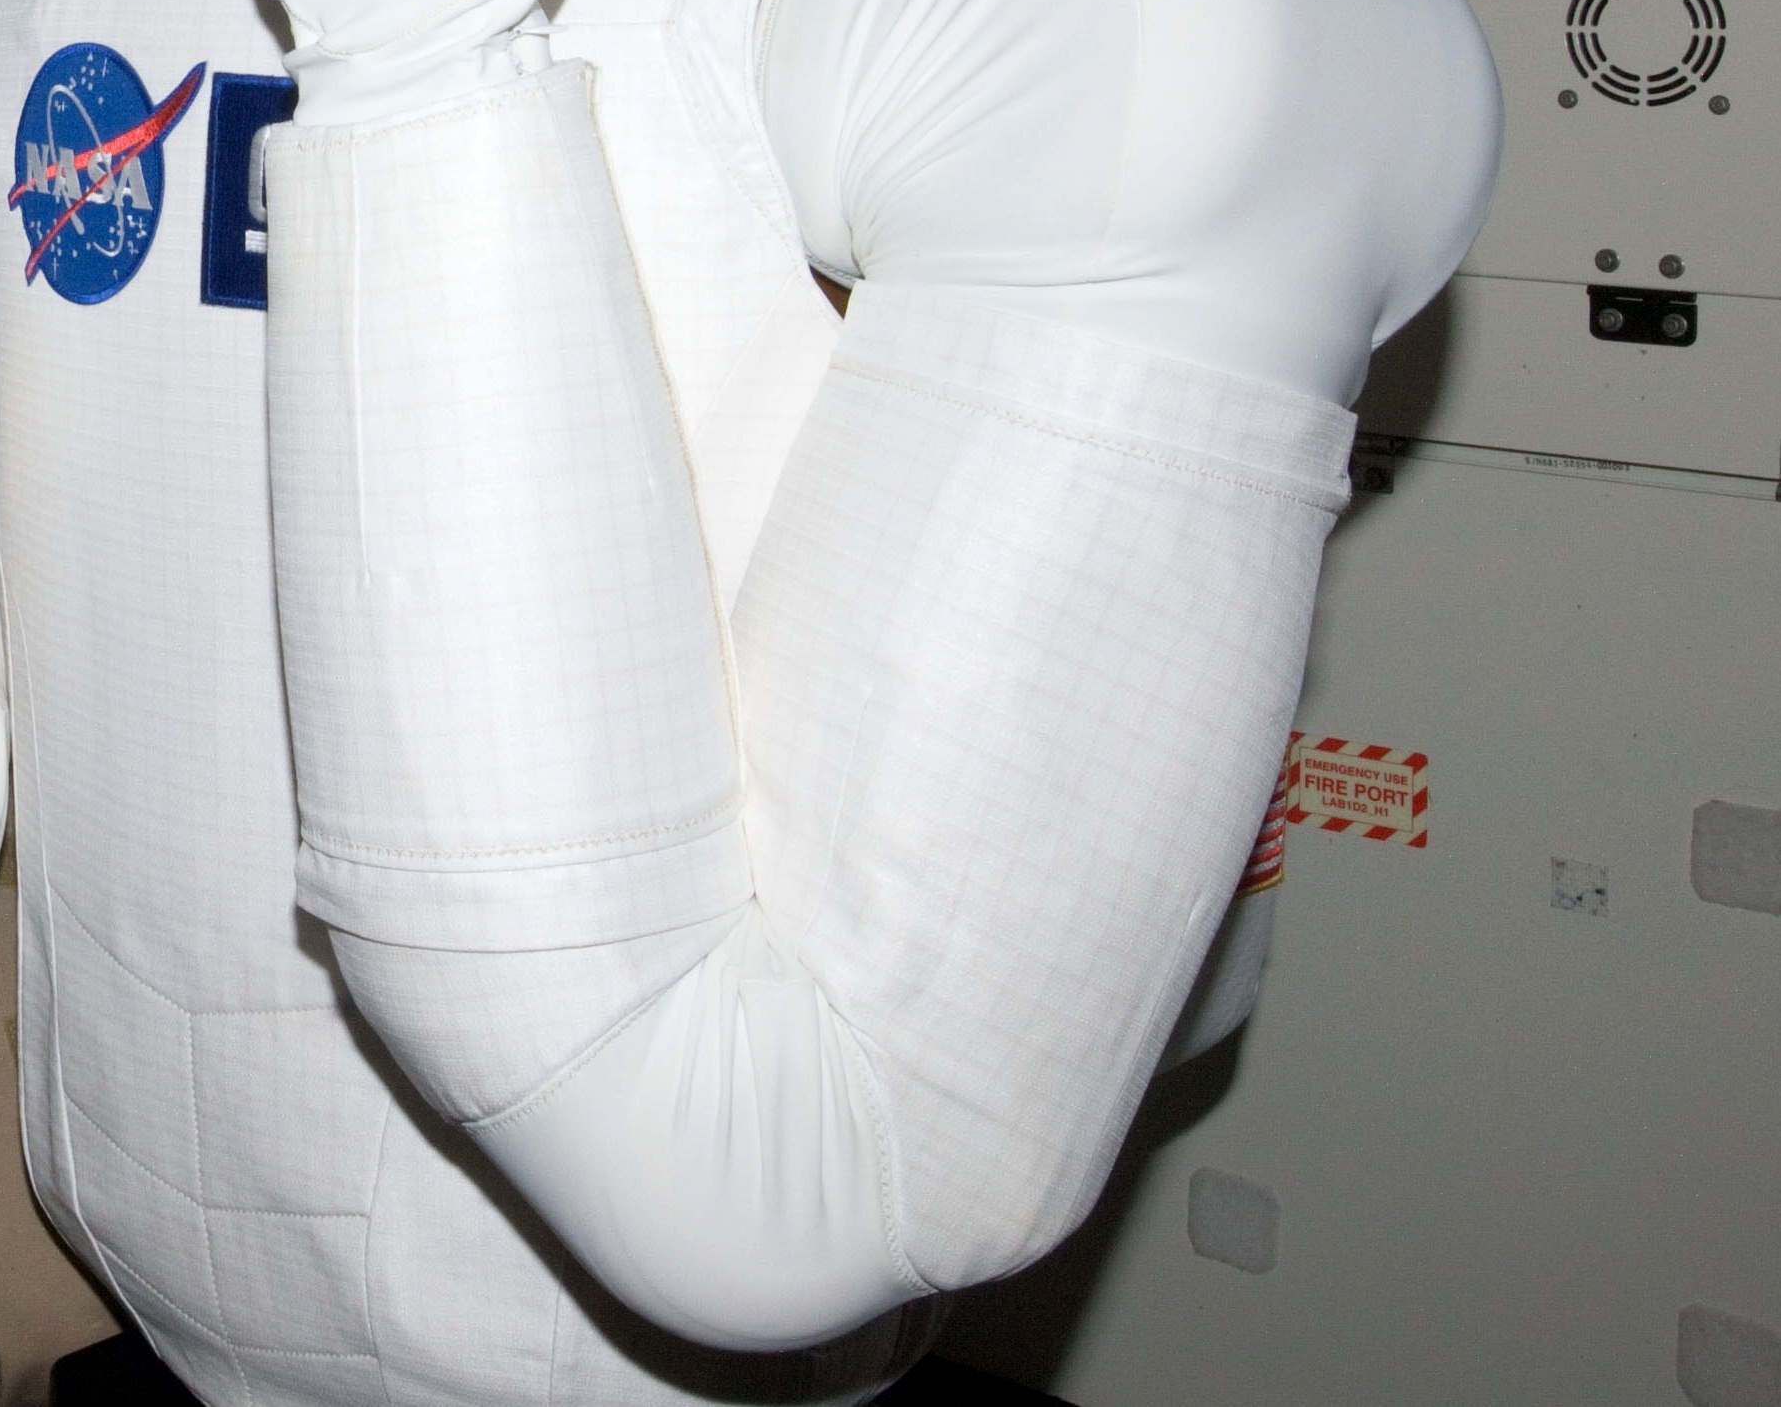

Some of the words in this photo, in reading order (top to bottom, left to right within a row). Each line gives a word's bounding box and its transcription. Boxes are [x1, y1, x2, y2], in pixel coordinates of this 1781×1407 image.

[24, 141, 154, 211] NASA
[1304, 758, 1381, 781] EMERGENCY
[1383, 772, 1409, 786] USE
[1304, 774, 1349, 797] FIRE
[1354, 782, 1410, 807] PORT
